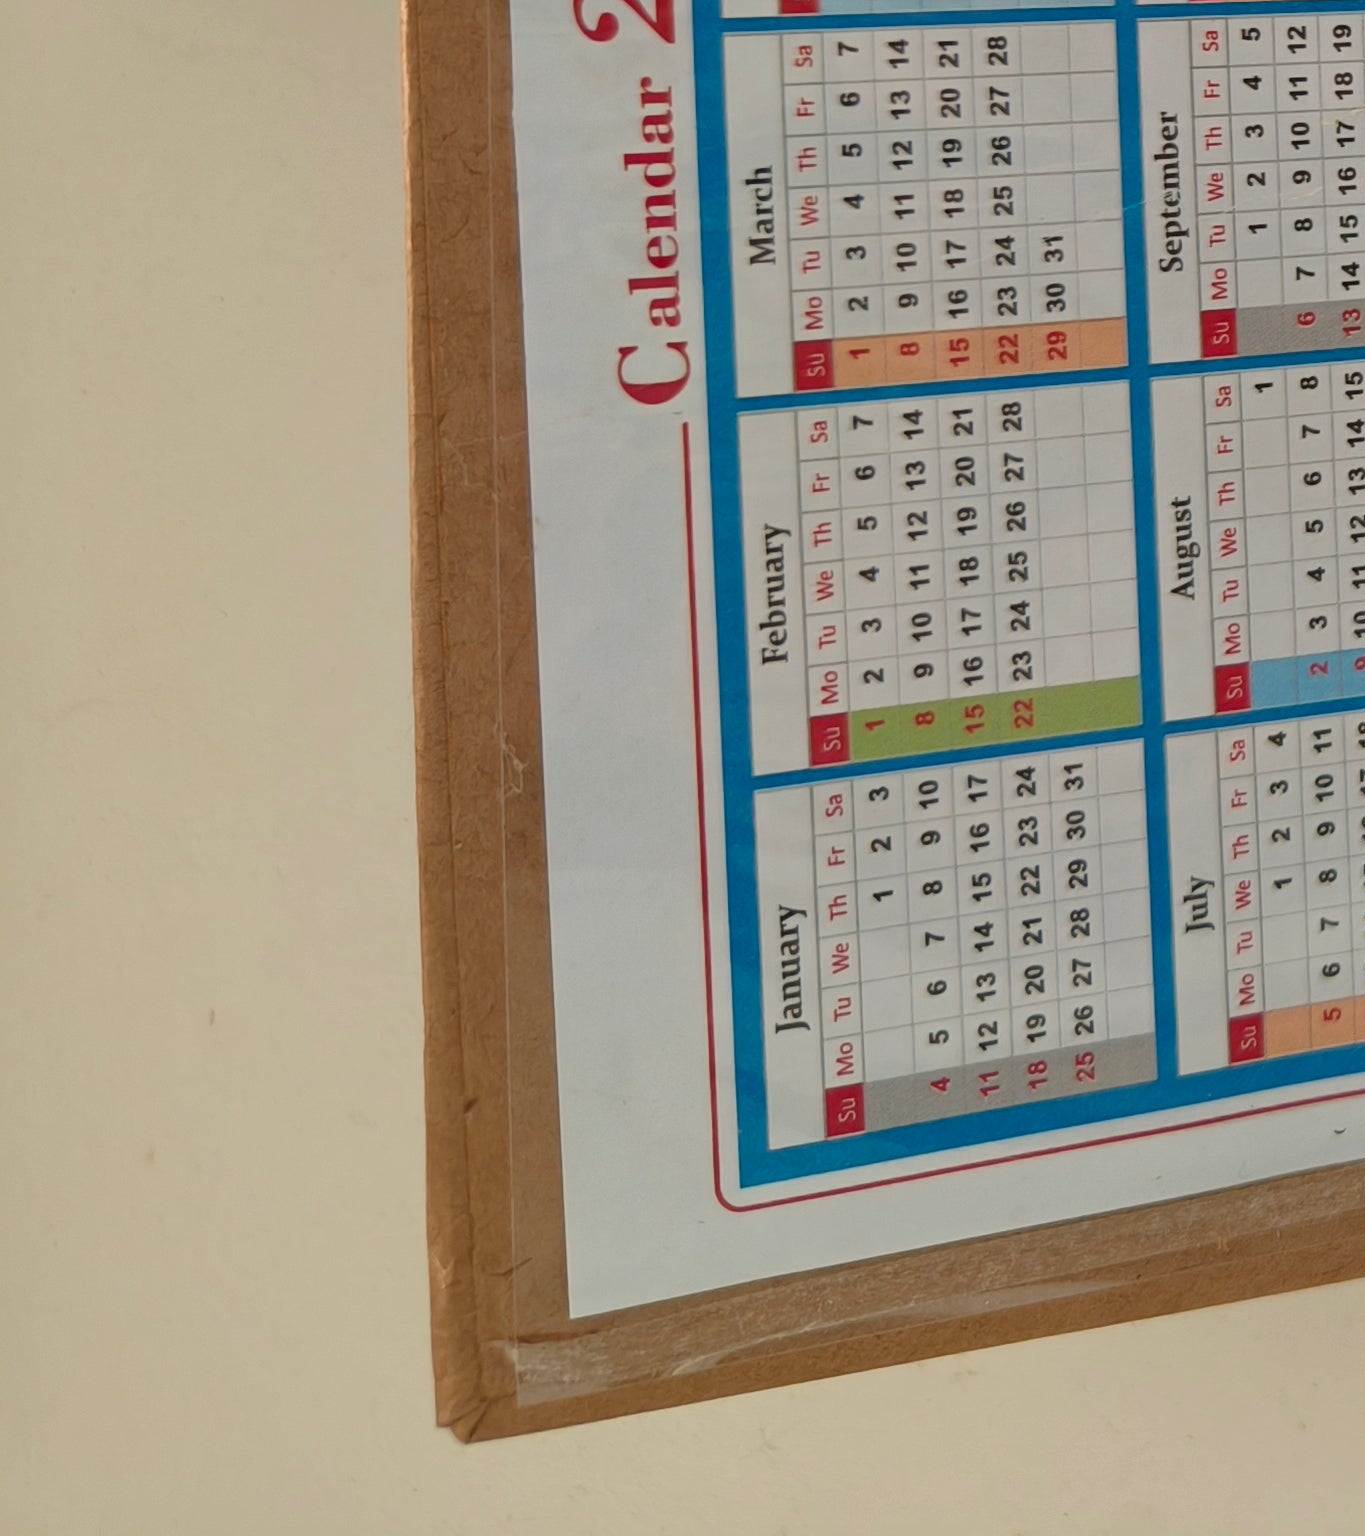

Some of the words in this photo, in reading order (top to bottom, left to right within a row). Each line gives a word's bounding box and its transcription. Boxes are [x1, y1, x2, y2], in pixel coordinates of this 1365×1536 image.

[986, 34, 1009, 67] 28
[1200, 29, 1221, 53] Sa
[987, 85, 1011, 117] 27
[1201, 78, 1222, 100] Fr
[989, 134, 1013, 167] 26
[1202, 125, 1225, 153] Th
[991, 184, 1015, 218] 25
[1152, 110, 1191, 274] September
[1205, 171, 1226, 203] We
[743, 165, 777, 266] March
[616, 75, 692, 406] Calendar
[993, 234, 1017, 267] 24
[1207, 223, 1228, 250] Tu
[1209, 266, 1229, 302] Mo
[995, 285, 1019, 318] 23
[995, 332, 1021, 366] 22
[1211, 320, 1231, 346] Su
[1343, 370, 1365, 402] 15
[851, 414, 875, 431] 7
[853, 464, 877, 482] 6
[855, 514, 879, 532] 5
[1169, 494, 1202, 602] August
[857, 565, 881, 584] 4
[758, 522, 793, 666] February
[859, 616, 883, 634] 3
[861, 667, 886, 685] 2
[862, 718, 887, 733] 1
[966, 773, 989, 804] 17
[823, 792, 845, 819] Sa
[968, 821, 991, 854] 16
[825, 845, 846, 869] Fr
[970, 871, 994, 904] 15
[826, 893, 849, 924] Th
[1182, 875, 1217, 935] July
[972, 920, 996, 954] 14
[774, 903, 812, 1036] January
[830, 942, 851, 976] We
[974, 971, 998, 1004] 13
[832, 995, 853, 1024] Tu
[976, 1019, 1000, 1053] 12
[834, 1040, 856, 1078] Mo
[976, 1069, 1002, 1099] 11
[836, 1096, 858, 1124] Su
